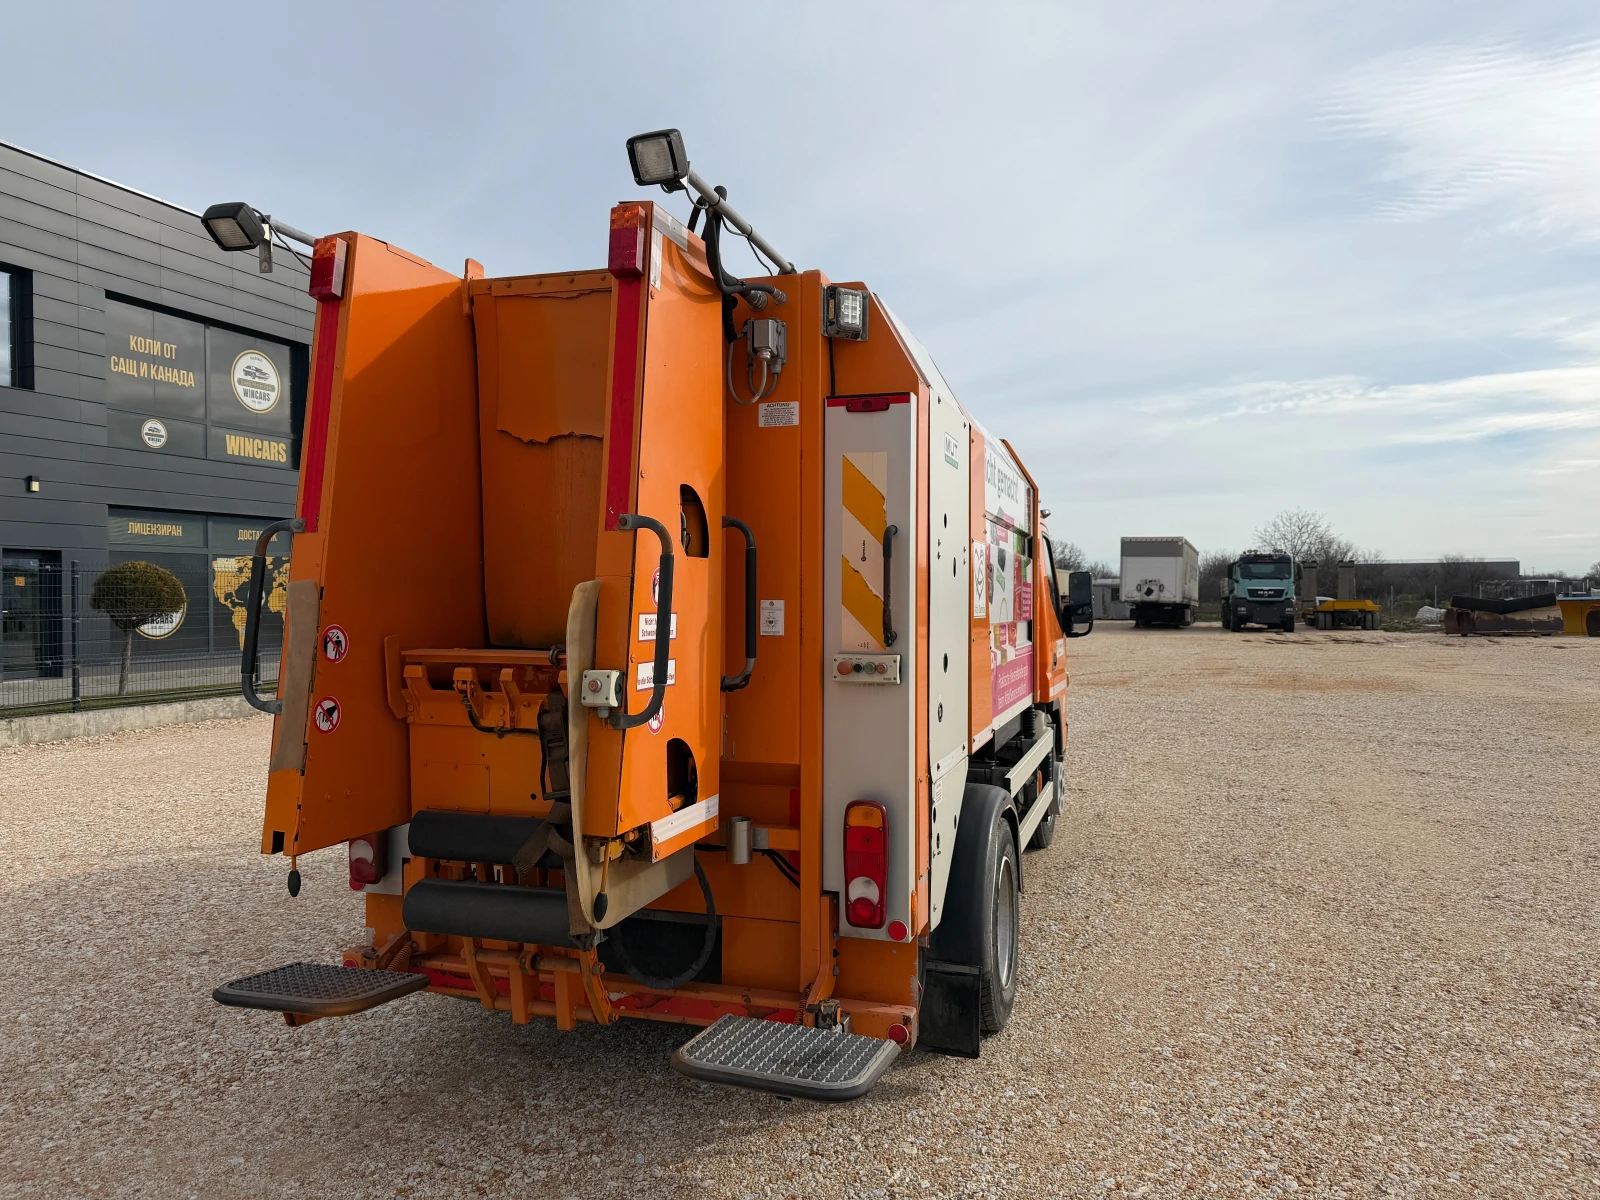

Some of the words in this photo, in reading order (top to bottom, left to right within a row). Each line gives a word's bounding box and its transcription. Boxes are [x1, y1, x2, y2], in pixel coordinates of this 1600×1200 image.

[129, 335, 162, 355] КОЛИ
[163, 343, 177, 360] ОТ
[110, 355, 138, 377] САЩ
[139, 362, 148, 377] И
[150, 364, 195, 387] КАНАДА
[242, 388, 271, 402] WINCARS
[225, 434, 287, 463] WINCARS
[127, 521, 182, 537] ЛИЦЕНЗИРАН
